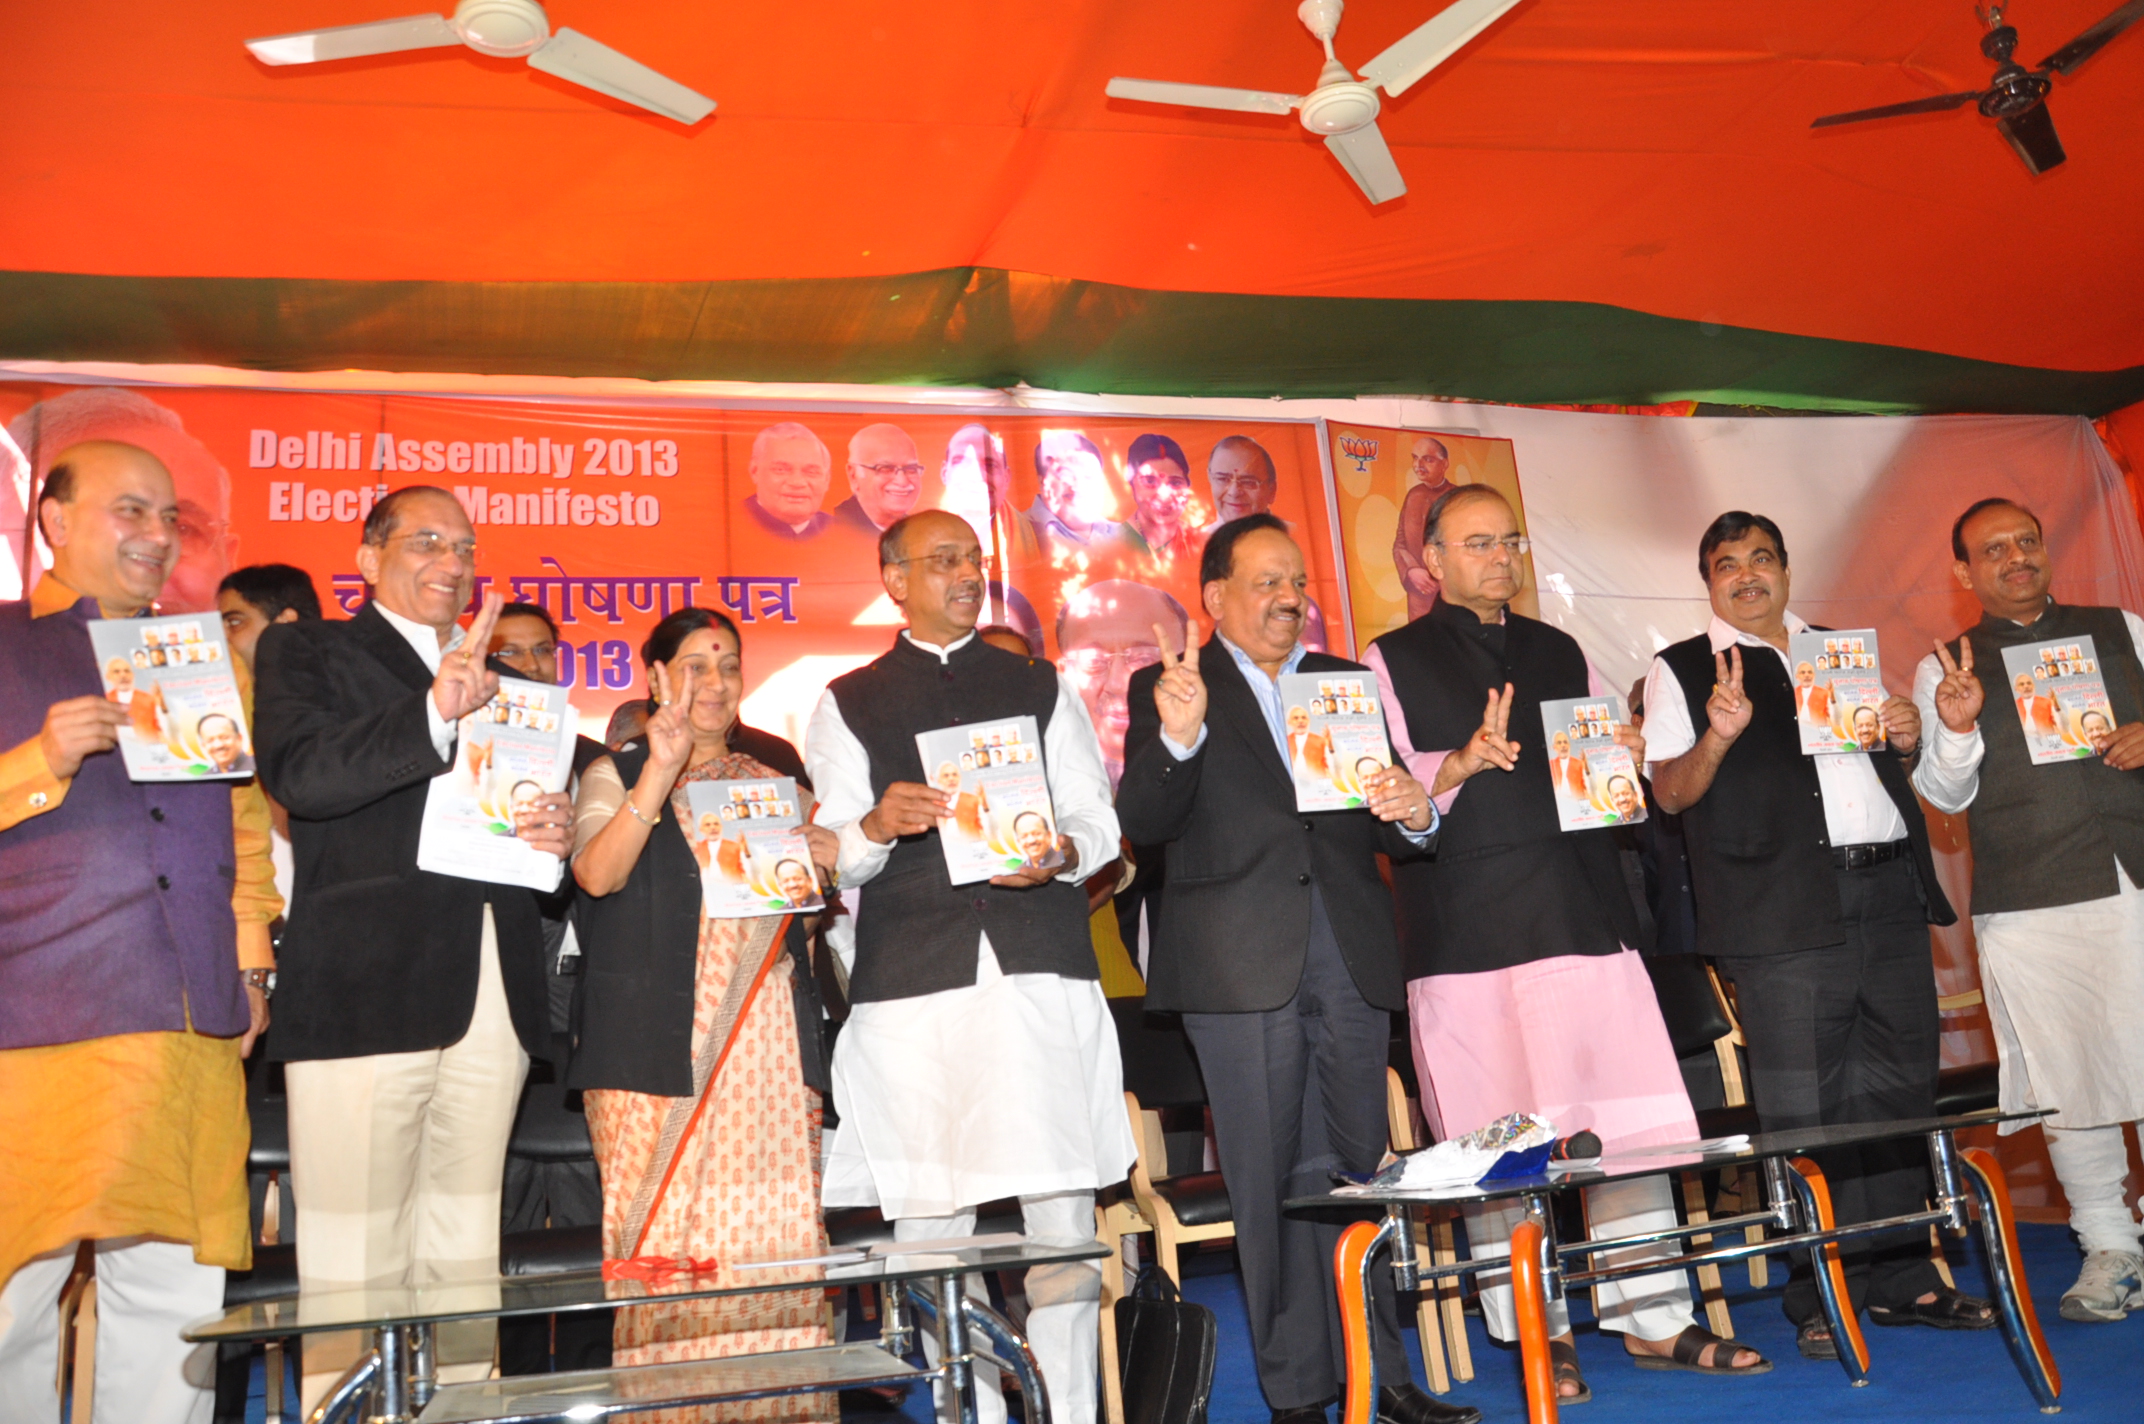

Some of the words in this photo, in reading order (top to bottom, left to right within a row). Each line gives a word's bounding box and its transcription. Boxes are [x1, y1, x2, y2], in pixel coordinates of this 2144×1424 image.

[249, 429, 362, 470] Delhi
[369, 432, 575, 479] Assembly
[583, 437, 680, 478] 2013
[453, 485, 661, 527] Manifesto
[509, 556, 702, 625] घोषणा
[717, 576, 800, 624] पत्र
[555, 640, 634, 691] 013
